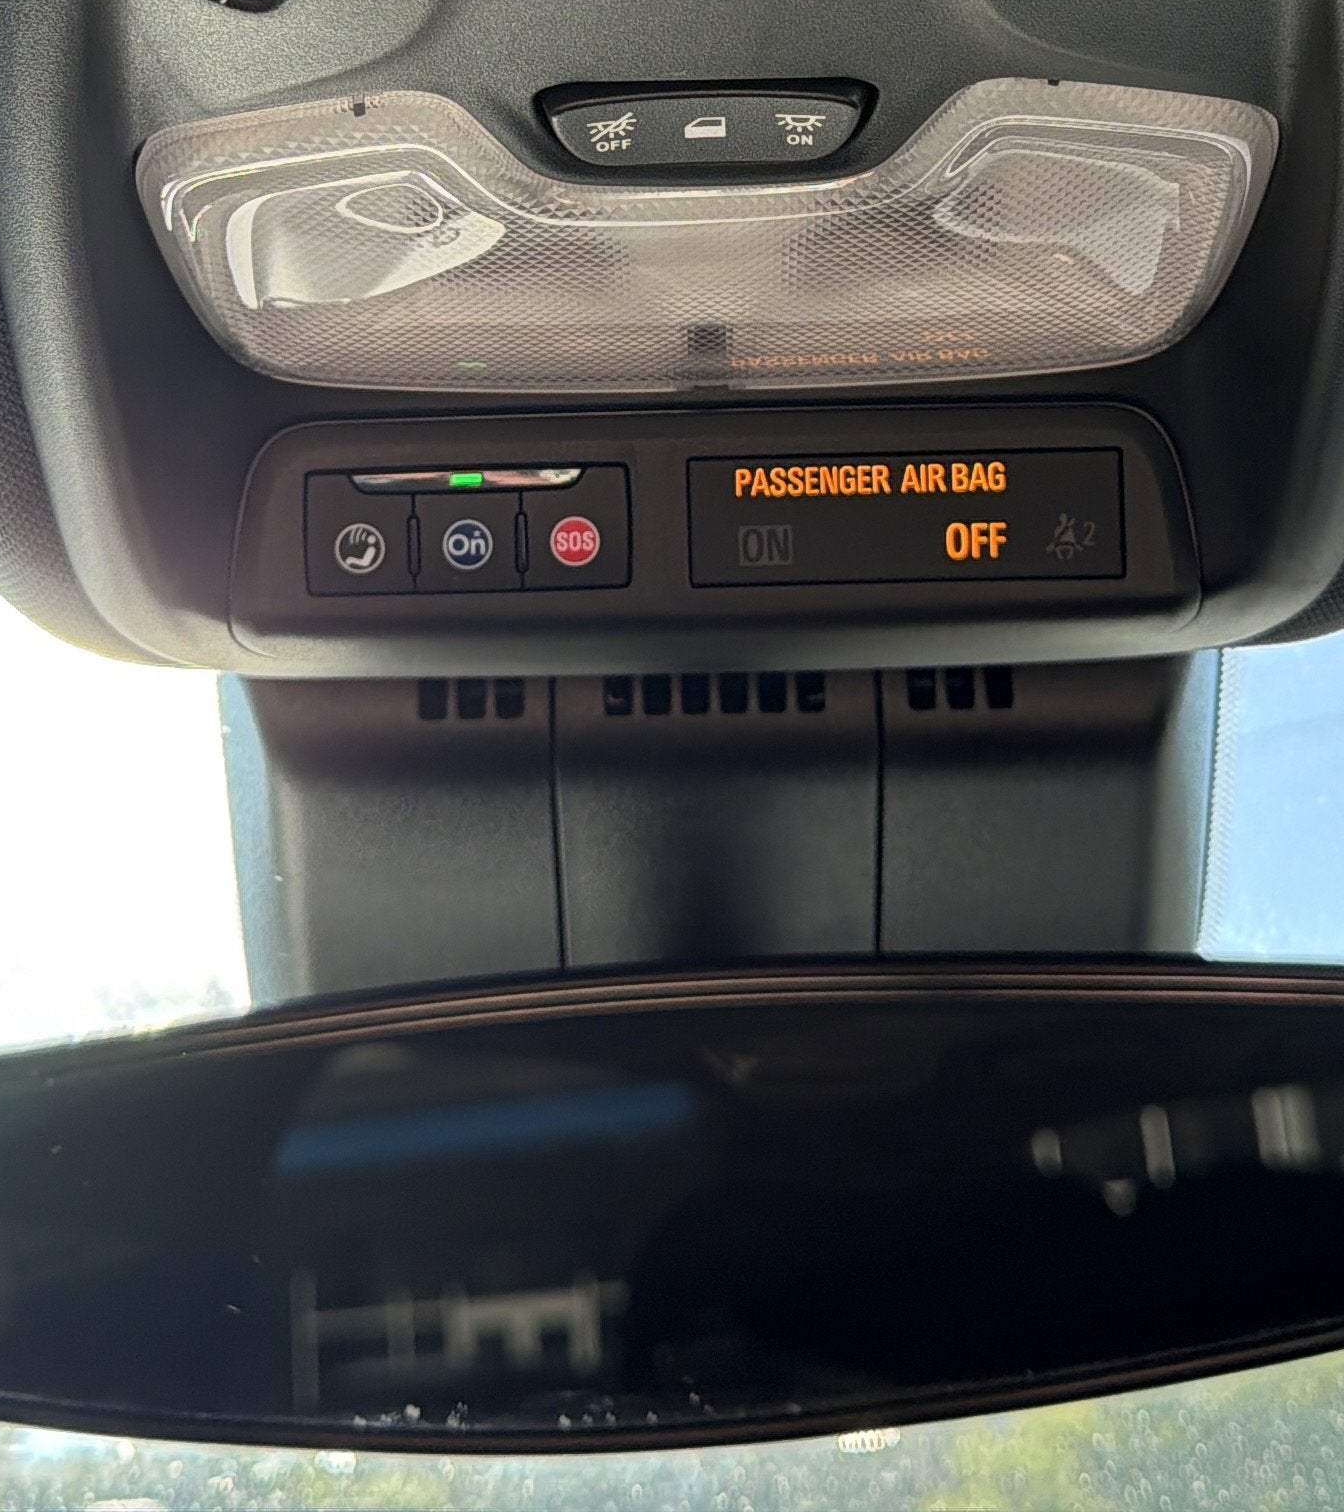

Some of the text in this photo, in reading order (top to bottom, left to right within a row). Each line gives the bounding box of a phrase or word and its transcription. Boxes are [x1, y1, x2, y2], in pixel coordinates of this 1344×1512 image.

[595, 138, 632, 153] OFF
[786, 133, 814, 146] ON
[735, 461, 1007, 498] PASSENGER AIR BAG
[447, 533, 487, 556] On
[555, 530, 595, 553] SOS
[742, 521, 1097, 564] ON OFF 2
